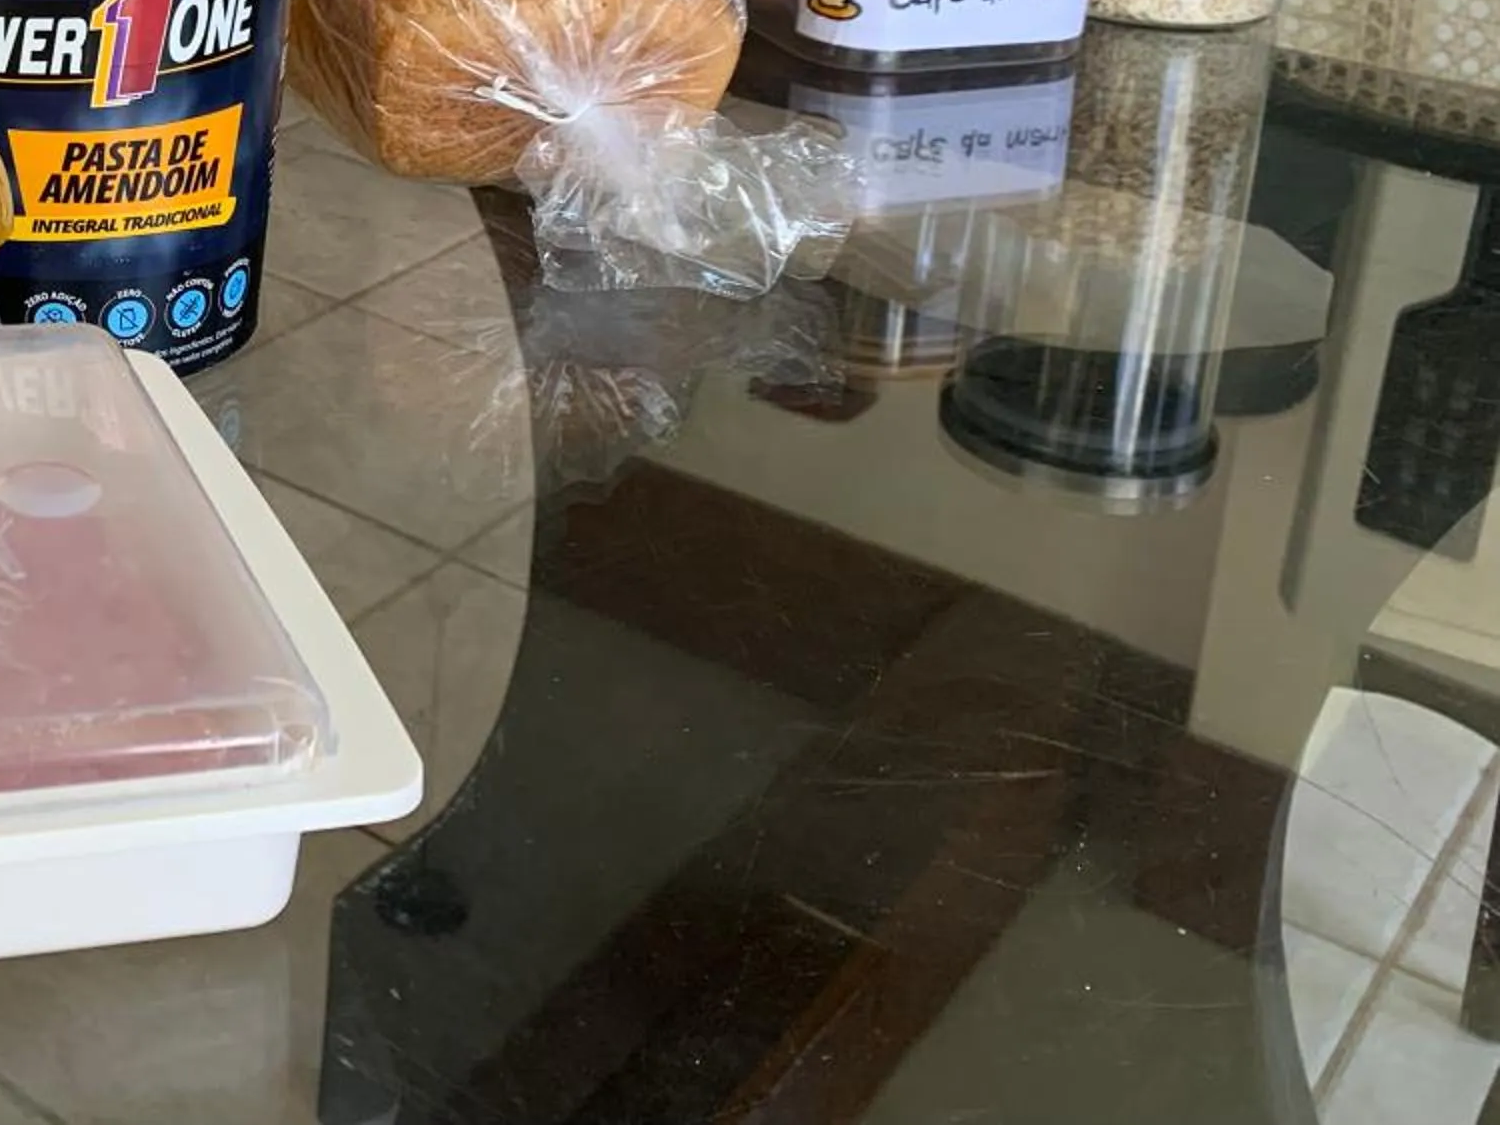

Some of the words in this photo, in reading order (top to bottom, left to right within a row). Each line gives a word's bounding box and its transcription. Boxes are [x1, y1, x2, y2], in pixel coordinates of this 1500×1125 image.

[61, 137, 163, 172] PASTA
[168, 128, 209, 167] DE
[38, 156, 220, 204] AMENDOIM
[31, 218, 118, 234] INTEGRAL
[123, 203, 222, 231] TRADICIONAL
